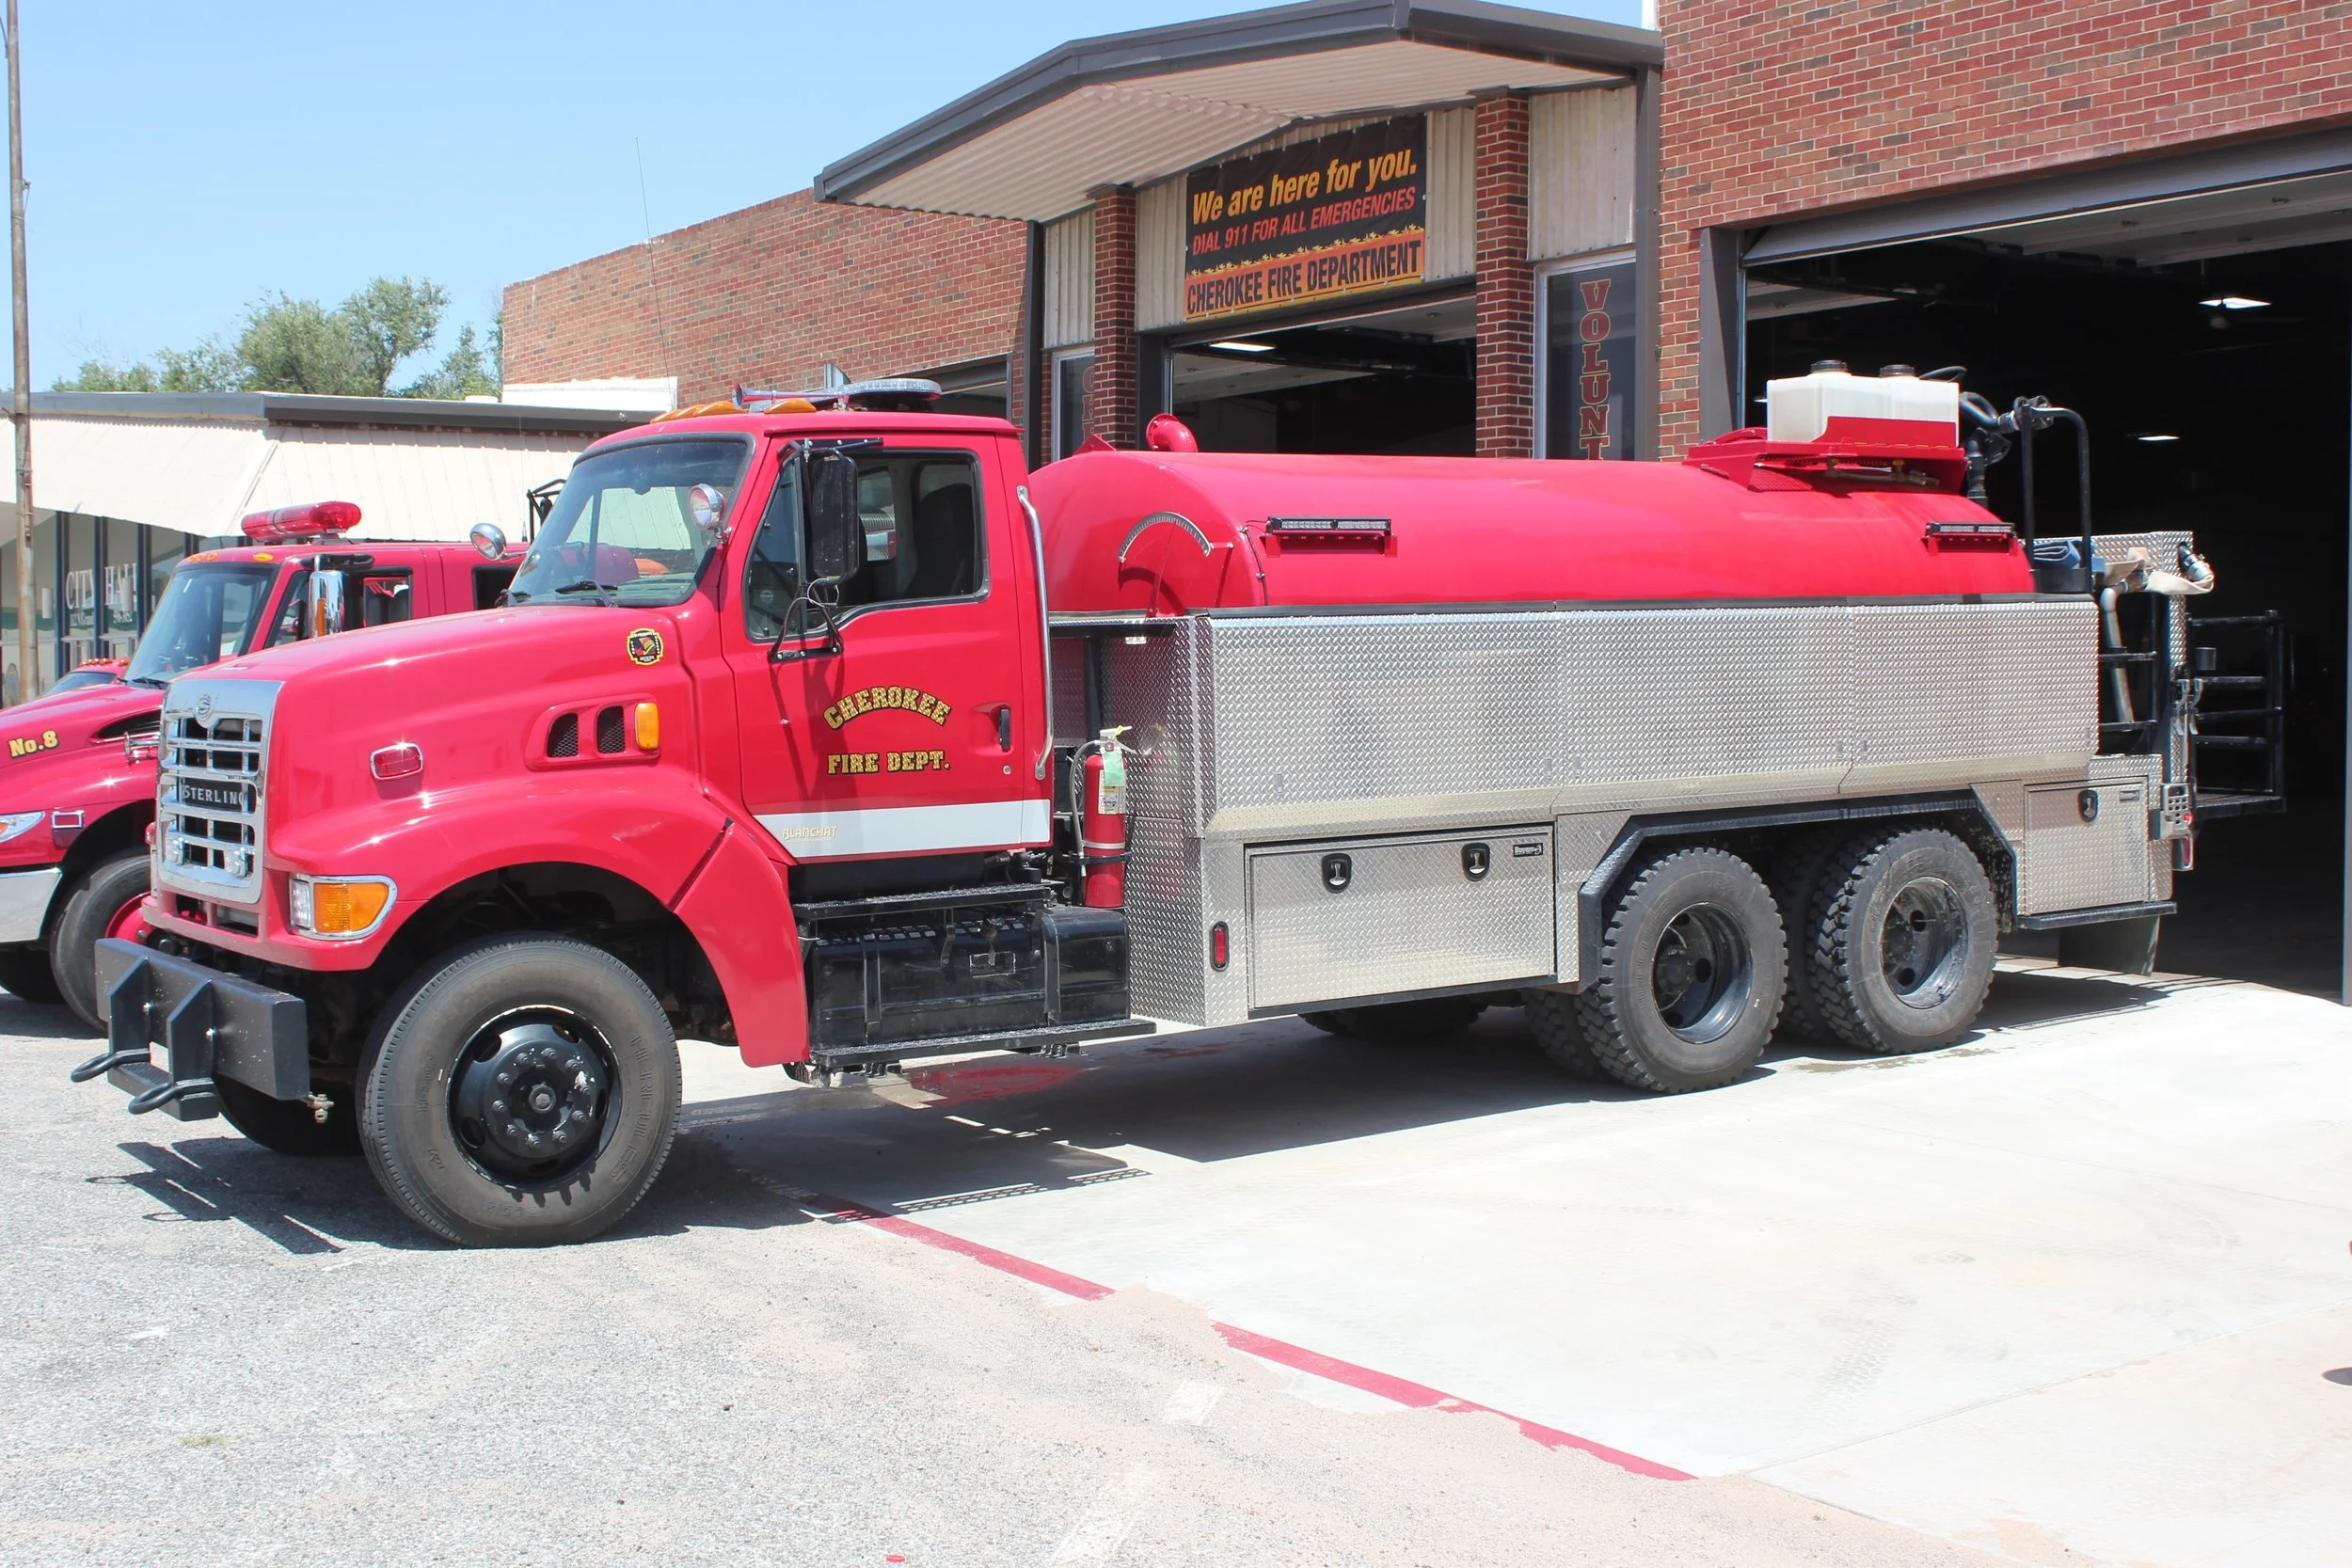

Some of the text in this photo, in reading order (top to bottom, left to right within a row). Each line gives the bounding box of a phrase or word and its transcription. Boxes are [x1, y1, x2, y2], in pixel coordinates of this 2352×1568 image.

[1192, 149, 1417, 225] We are here for you.
[1192, 186, 1416, 256] DIAL 911 FOR ALL EMERGENCIES
[1187, 240, 1421, 314] CHEROKEE FIRE DEPARTMENT
[823, 686, 951, 729] CHEROKEE
[827, 750, 950, 774] FIRE DEPT.
[783, 825, 837, 840] BLANCHAT
